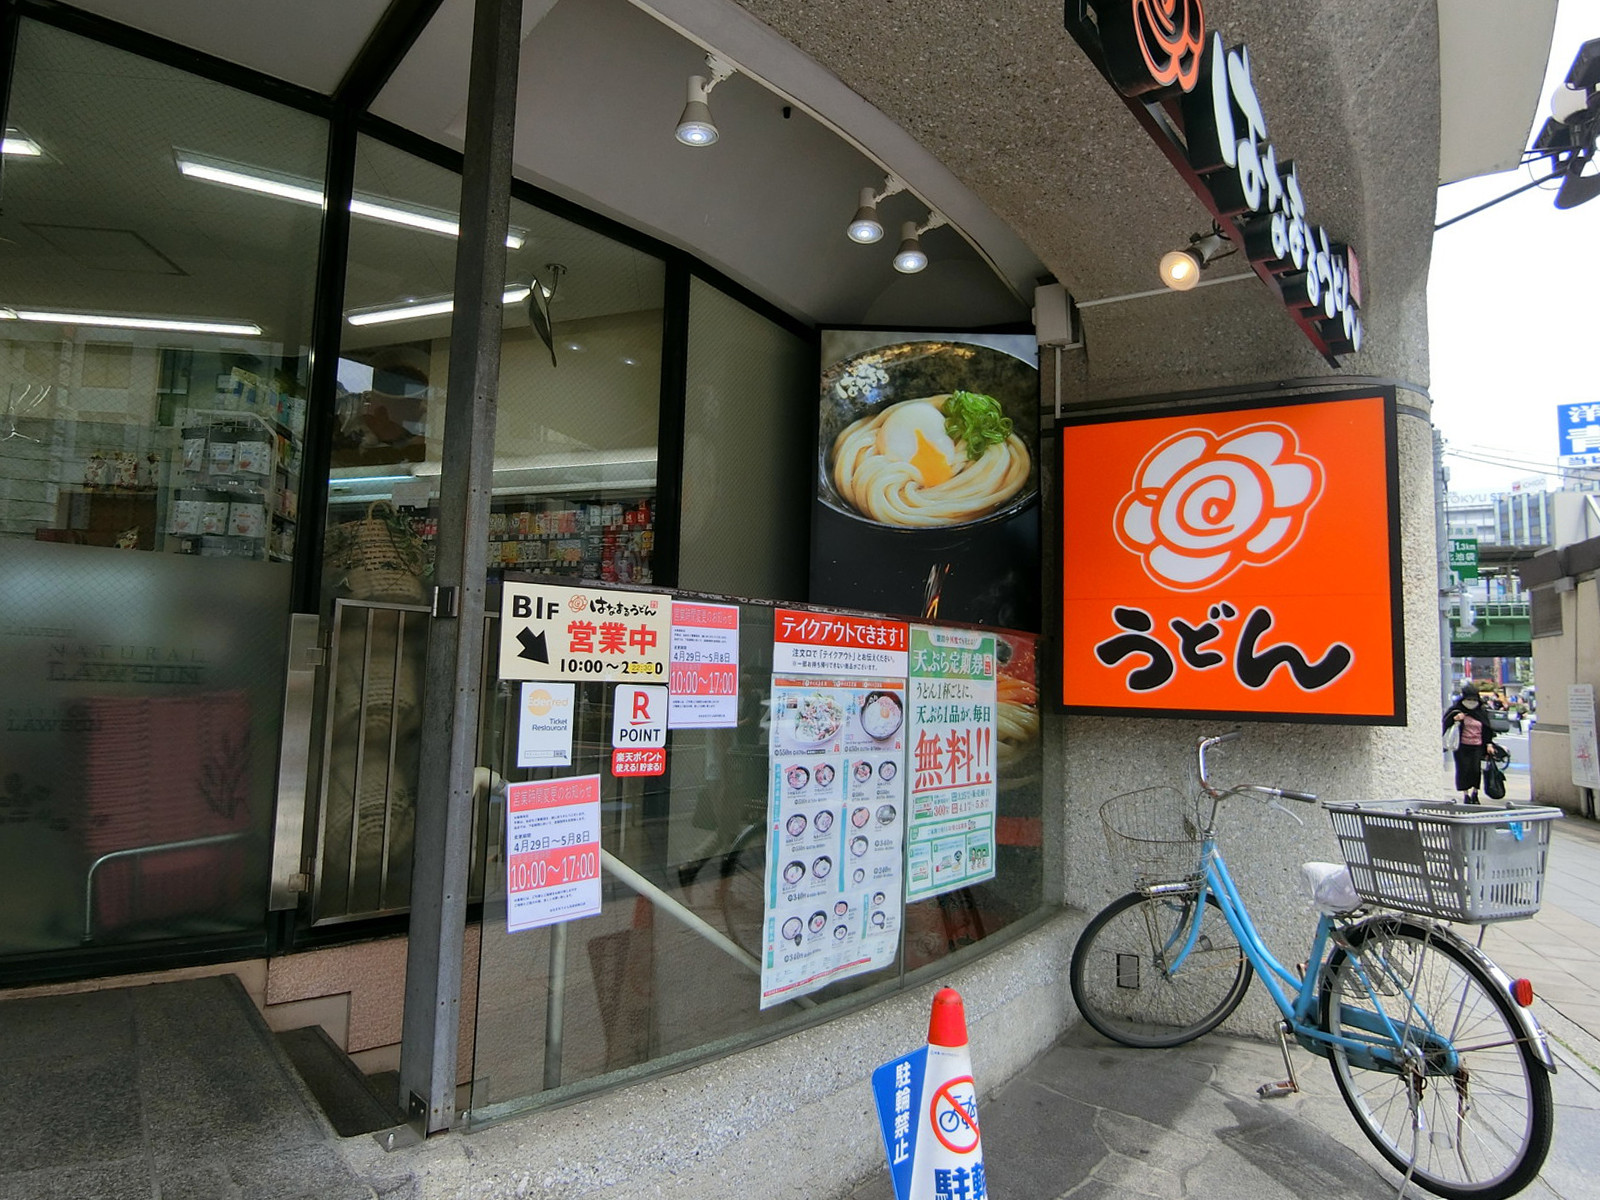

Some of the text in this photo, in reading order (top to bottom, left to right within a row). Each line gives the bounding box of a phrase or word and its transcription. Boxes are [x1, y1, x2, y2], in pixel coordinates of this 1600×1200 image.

[567, 620, 658, 656] 営業中
[1094, 600, 1354, 694] うどん
[633, 691, 650, 720] R
[619, 728, 661, 742] POINT
[616, 751, 662, 762] 楽天ポイント
